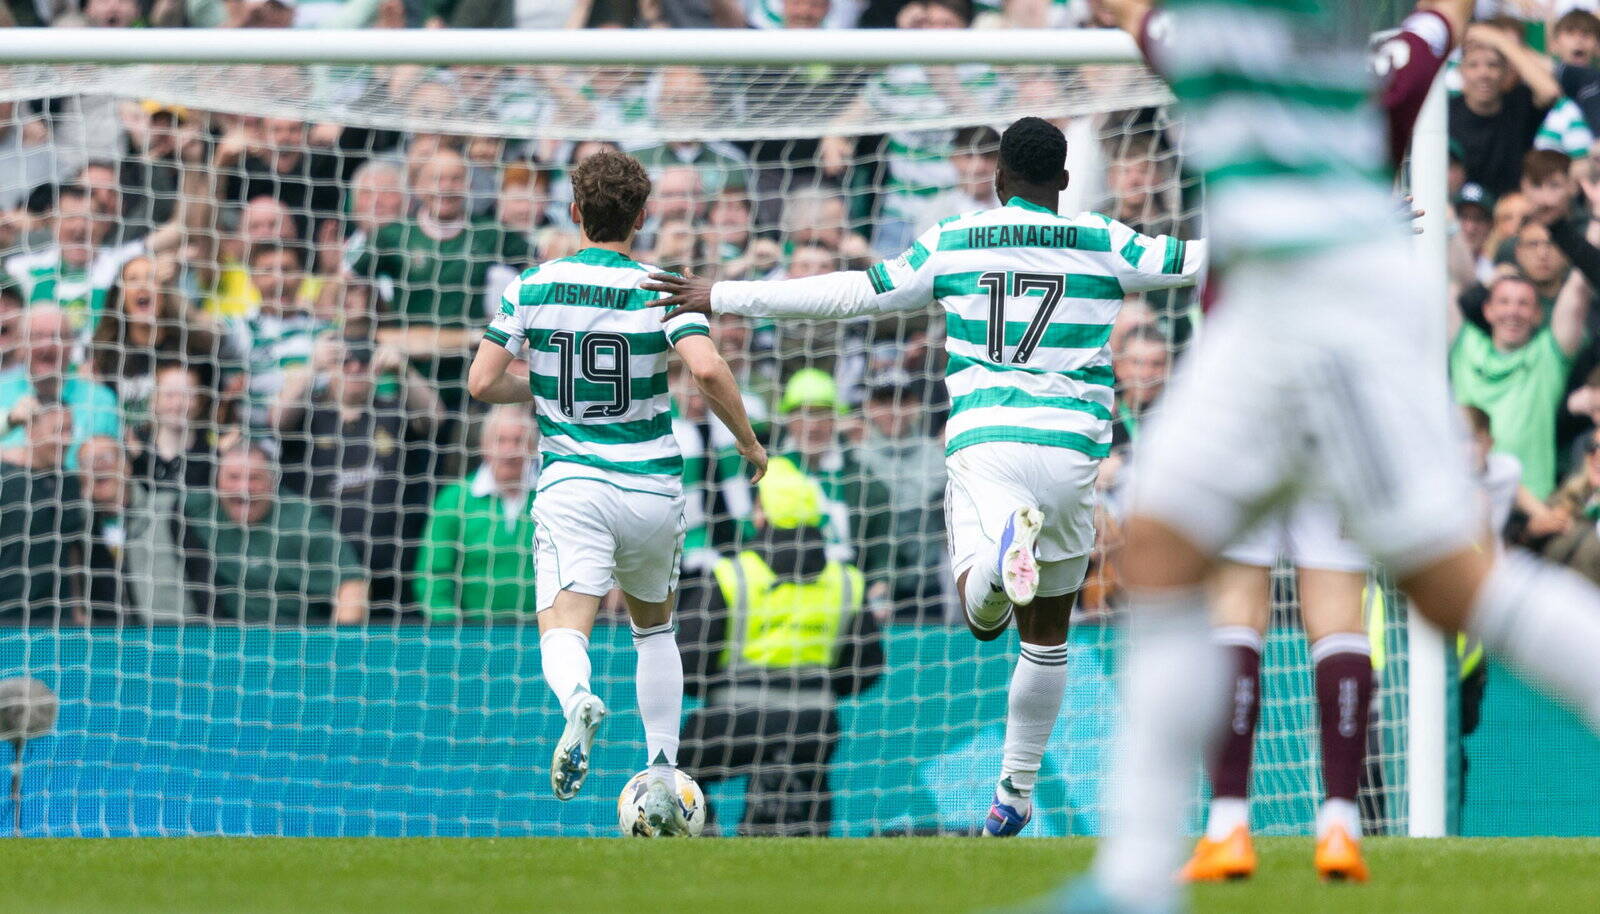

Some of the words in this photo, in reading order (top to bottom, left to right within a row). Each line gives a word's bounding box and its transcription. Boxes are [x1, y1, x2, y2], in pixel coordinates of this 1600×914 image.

[968, 225, 1078, 248] IHEANACHO
[554, 283, 629, 310] OSMAND
[977, 270, 1067, 365] 17
[548, 329, 632, 420] 19
